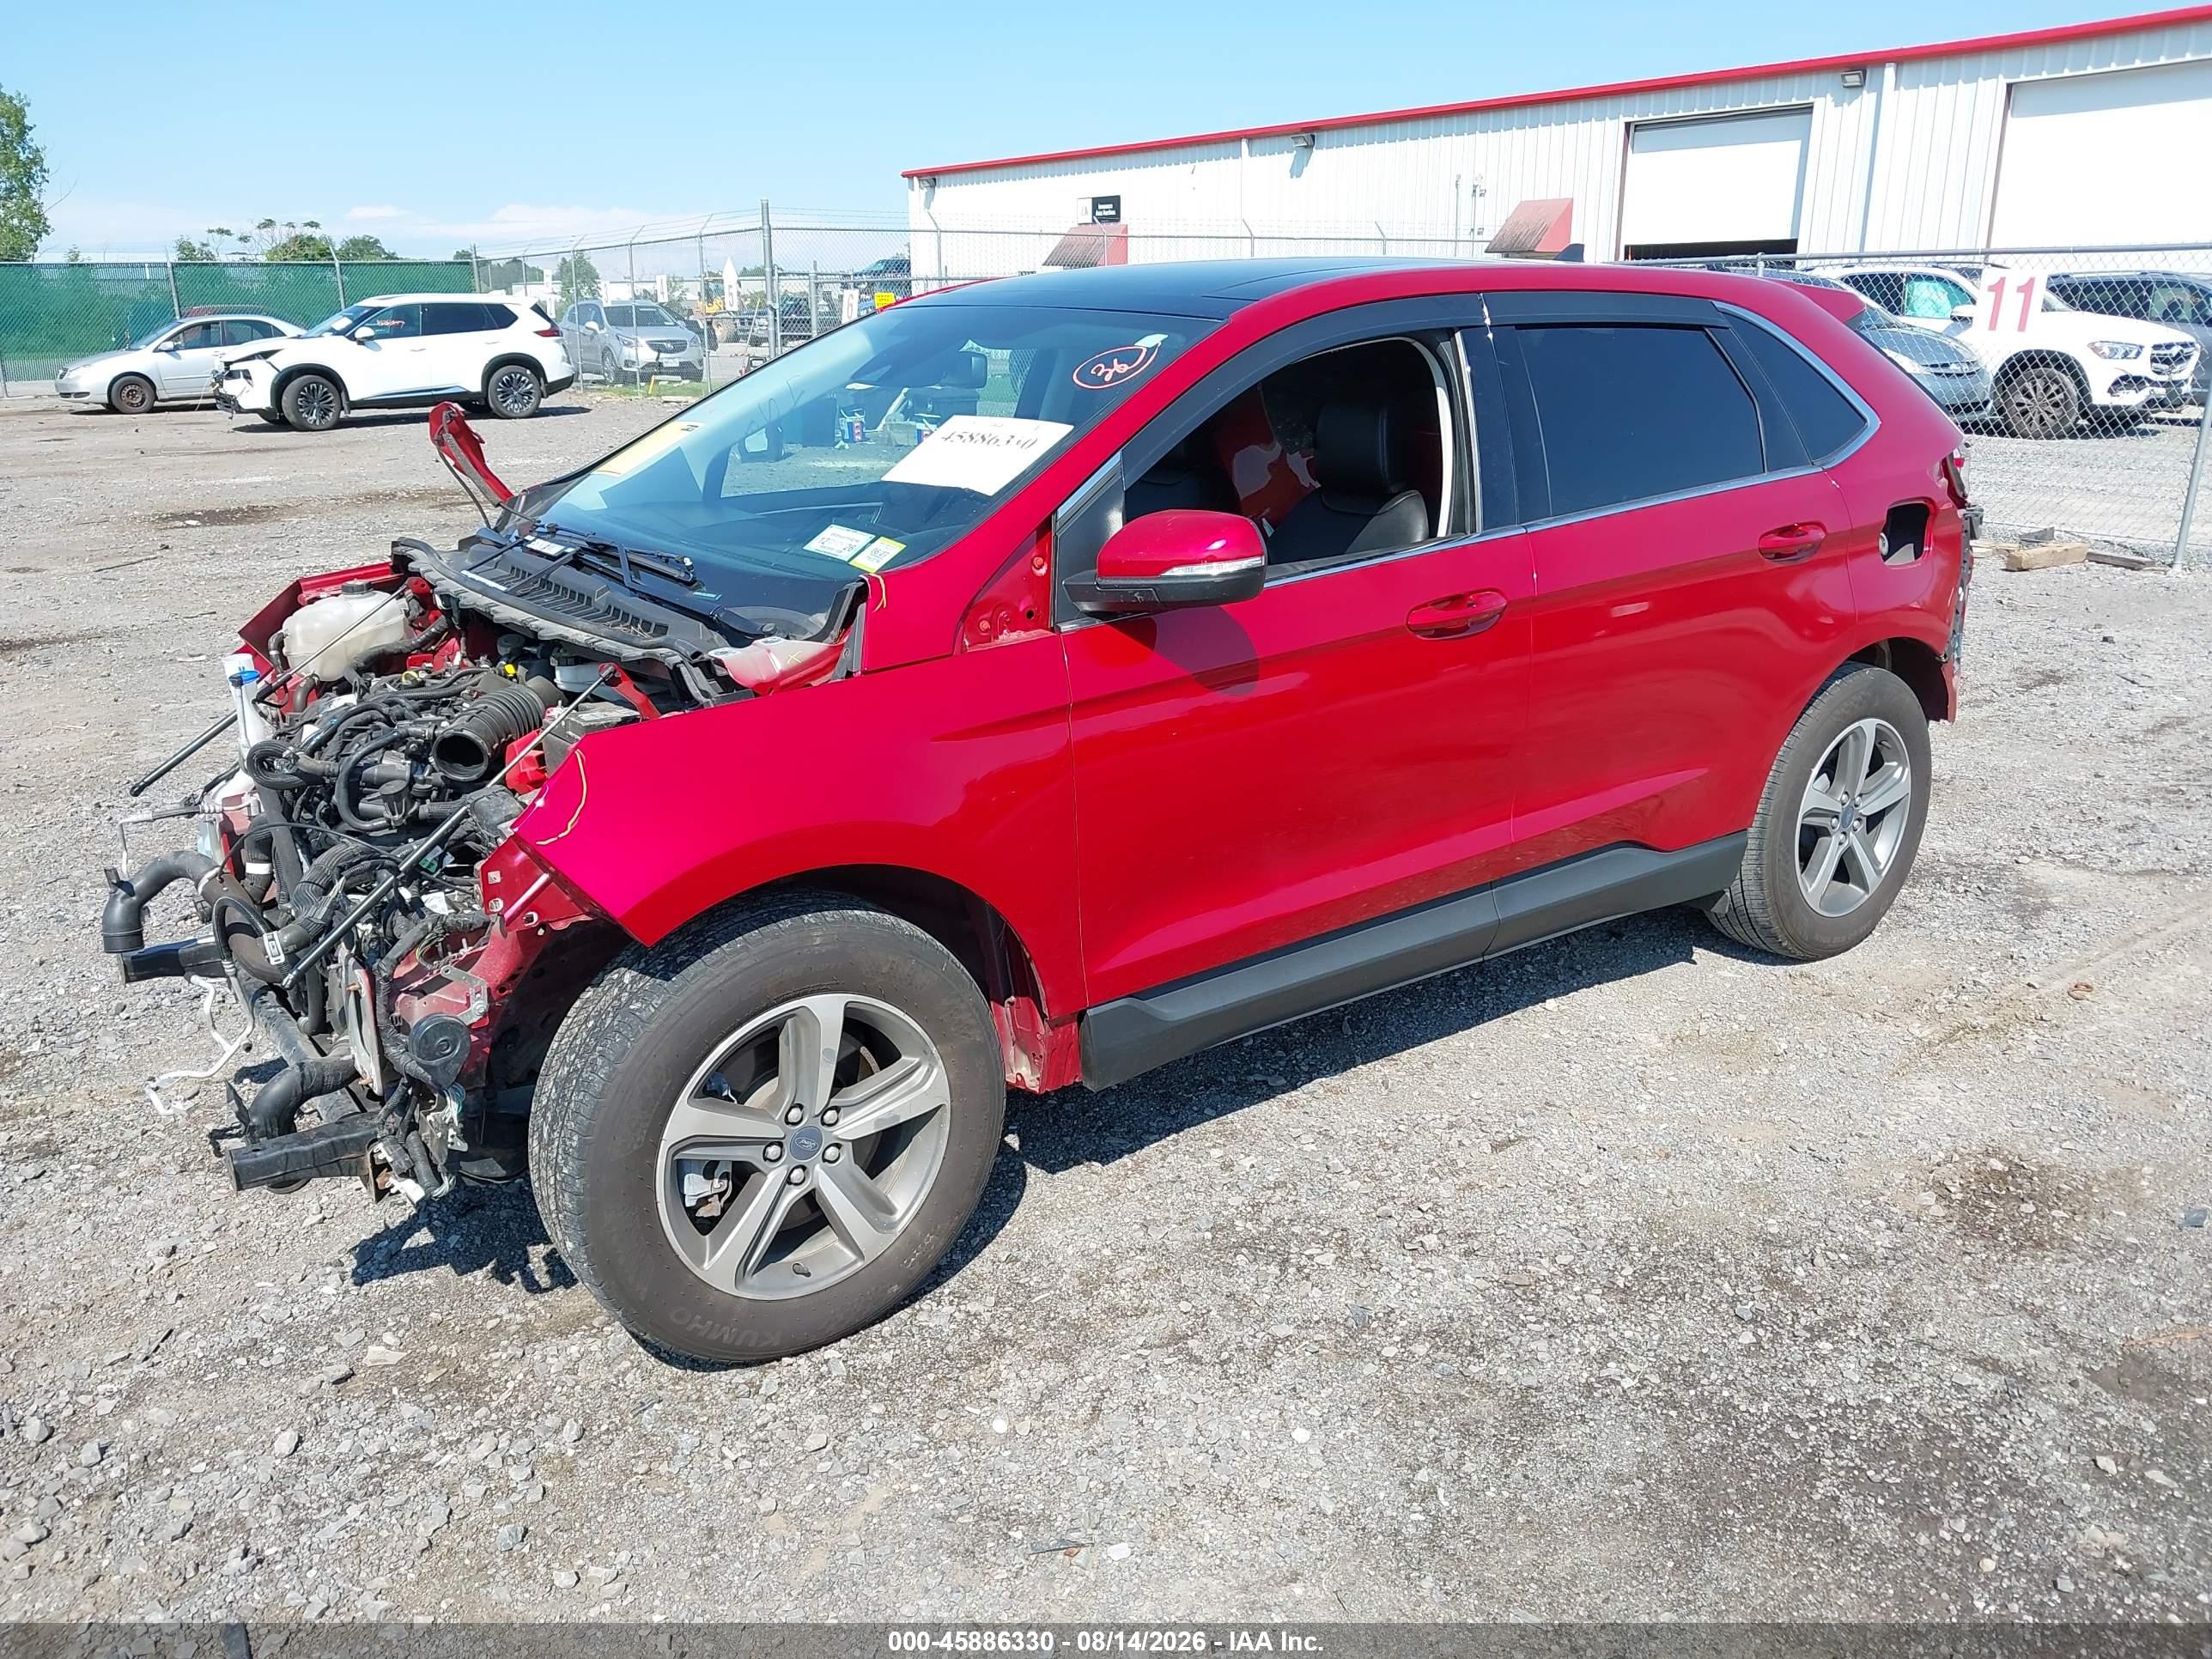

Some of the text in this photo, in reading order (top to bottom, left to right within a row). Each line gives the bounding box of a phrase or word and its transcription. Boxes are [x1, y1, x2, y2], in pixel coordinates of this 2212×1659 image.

[848, 294, 854, 319] 6
[1987, 276, 2036, 332] 11
[670, 1307, 784, 1346] KUMHO
